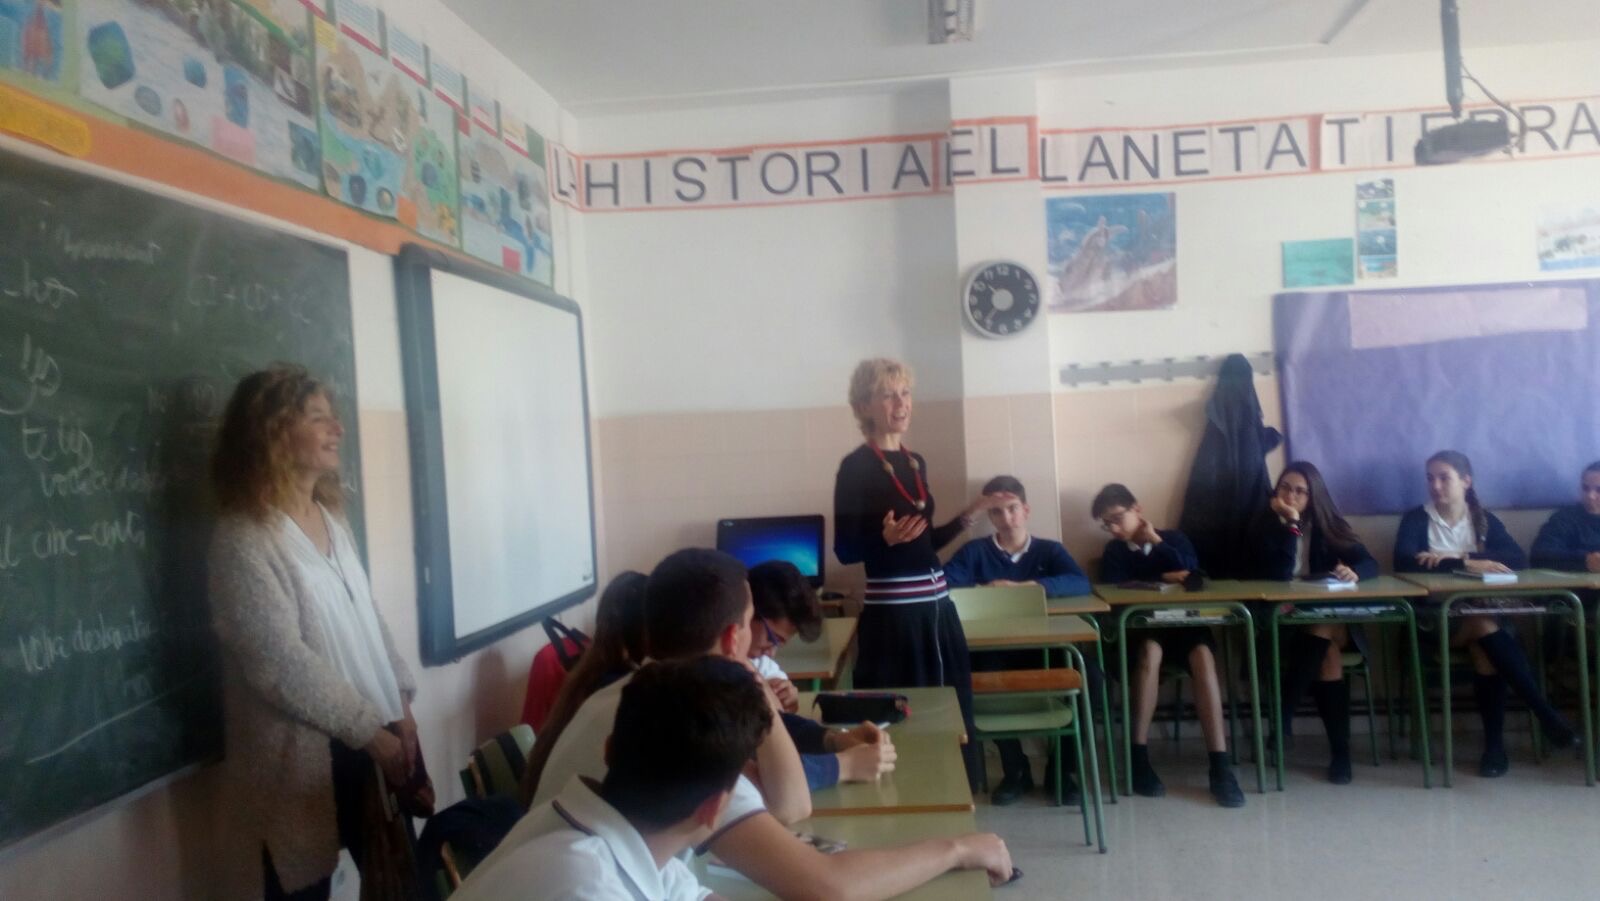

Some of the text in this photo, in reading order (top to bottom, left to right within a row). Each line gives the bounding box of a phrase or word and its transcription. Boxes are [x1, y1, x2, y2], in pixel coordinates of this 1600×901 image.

[583, 144, 931, 208] HISTORIA
[1040, 121, 1308, 183] LANETA
[1325, 102, 1600, 166] TIRA
